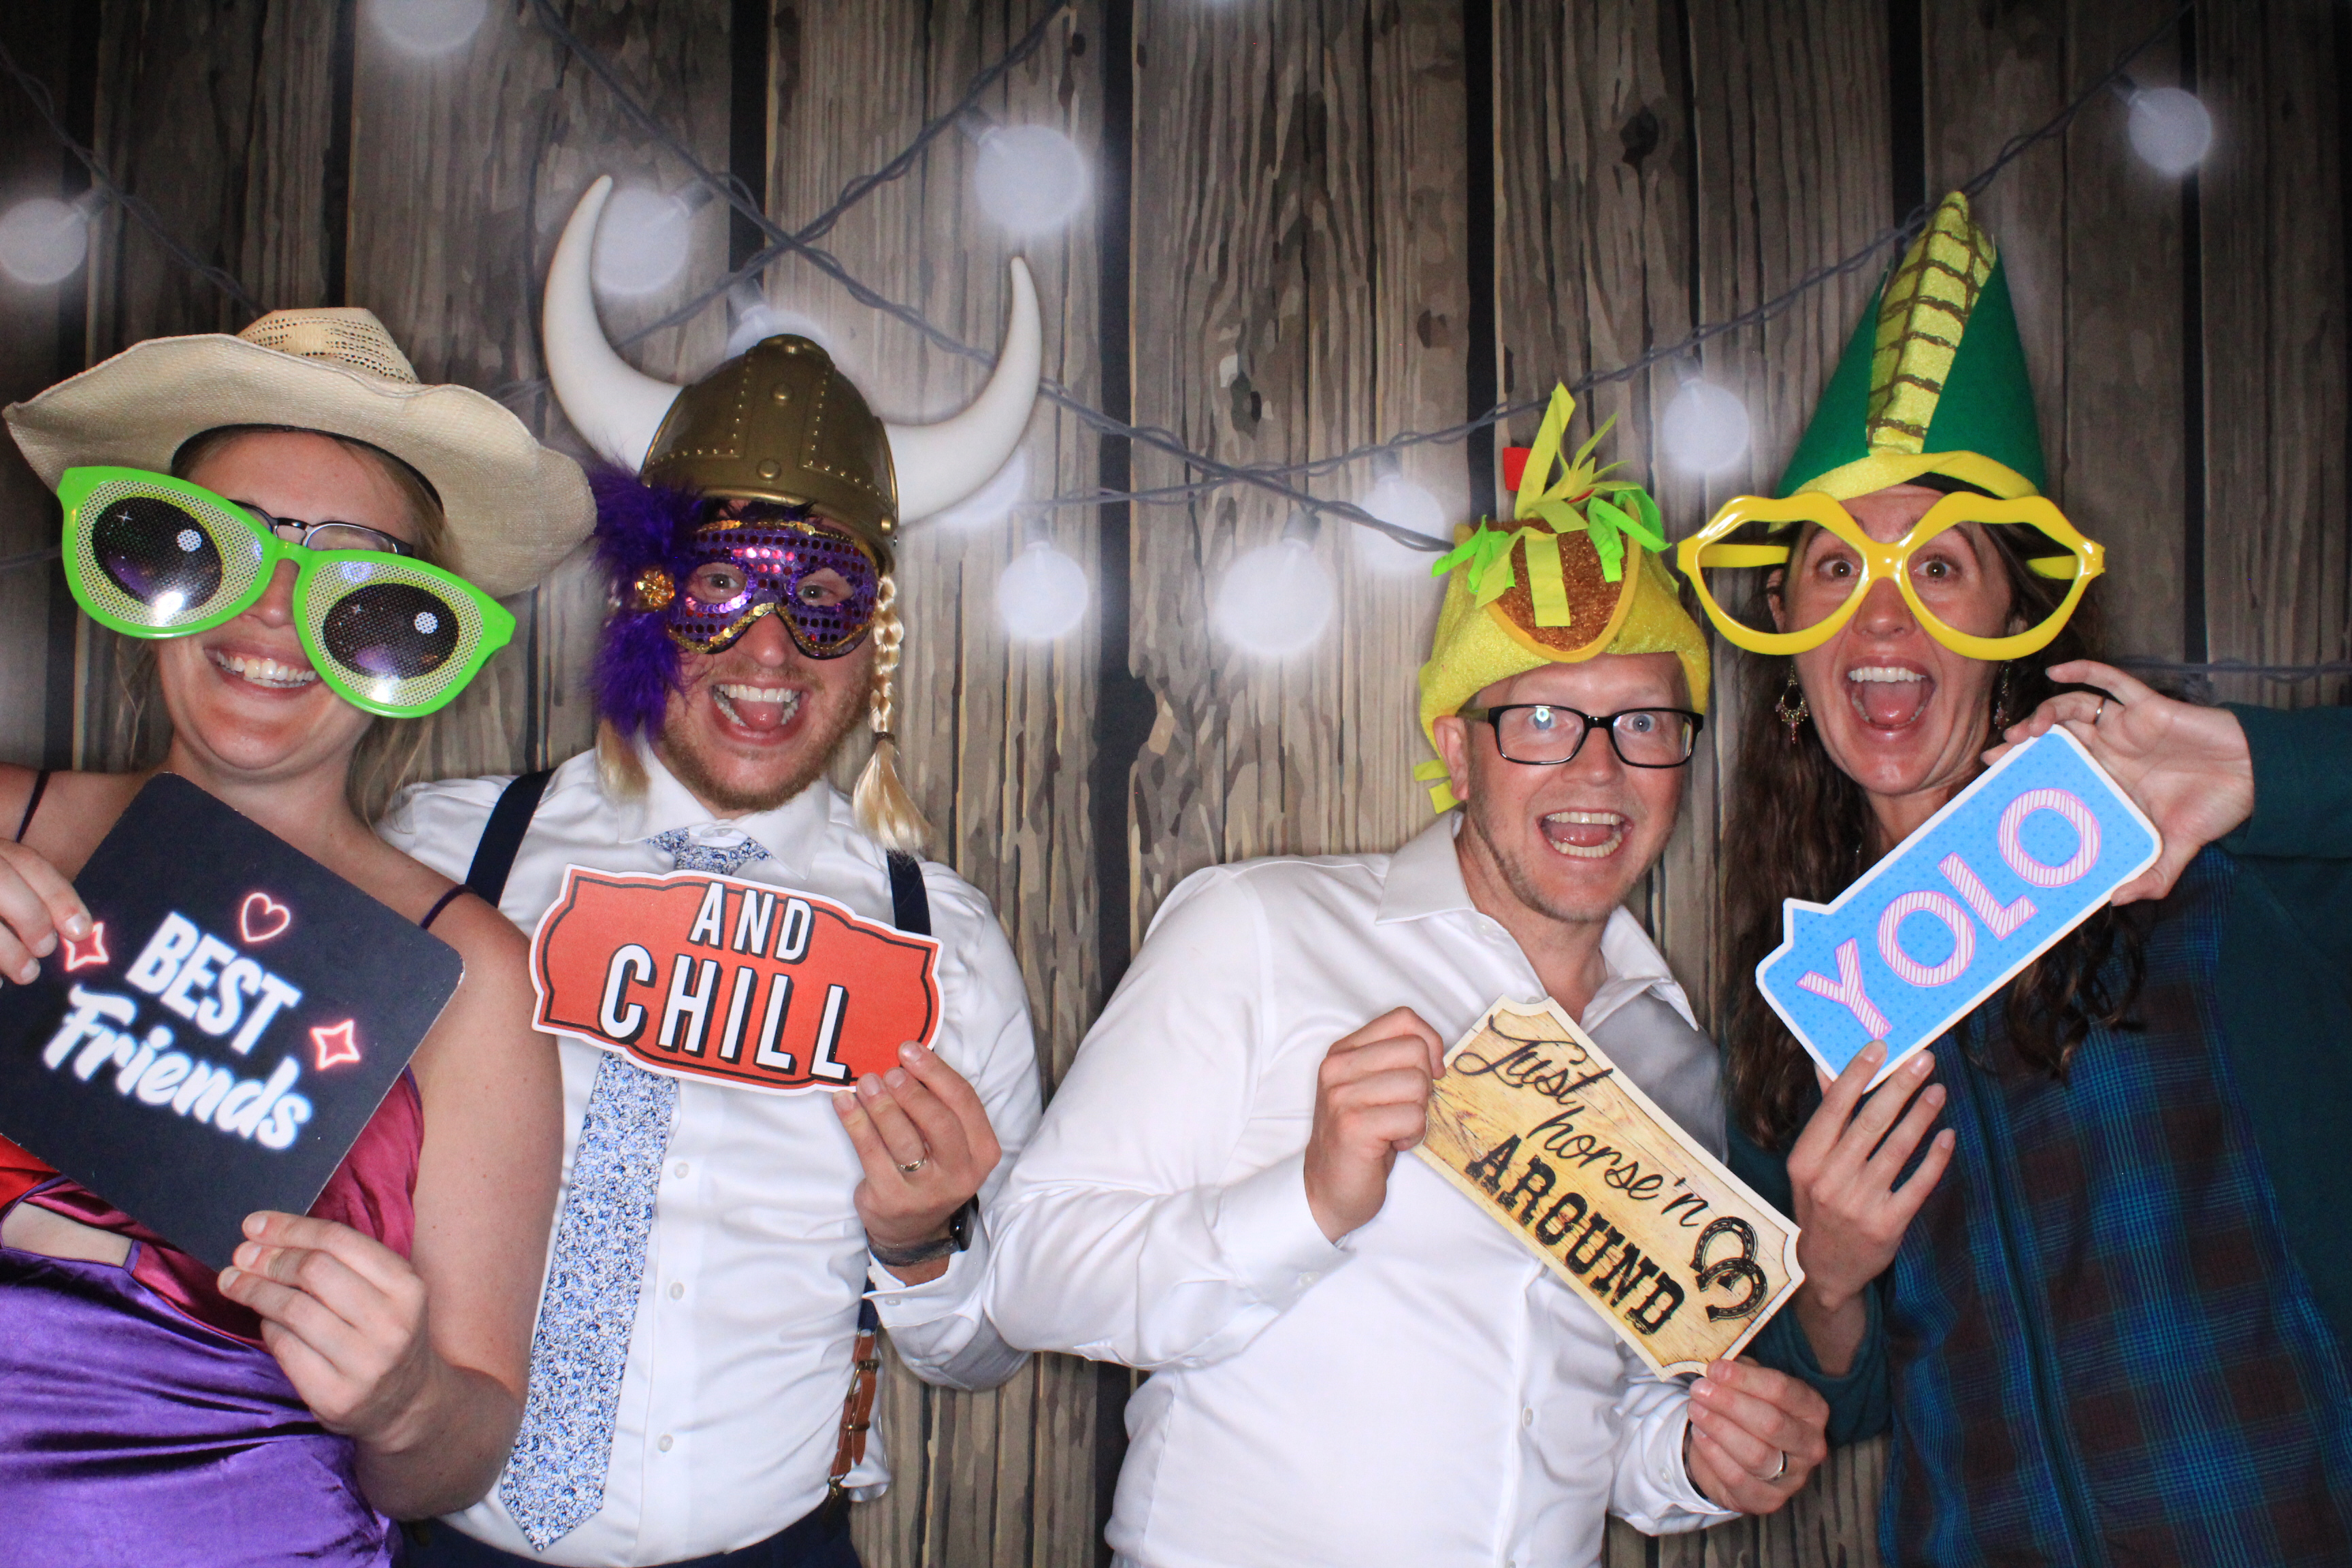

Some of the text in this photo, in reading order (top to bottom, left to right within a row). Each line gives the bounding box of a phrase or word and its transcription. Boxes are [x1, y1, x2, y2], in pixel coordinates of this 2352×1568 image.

[125, 911, 302, 1055] BEST
[689, 881, 814, 964] AND
[1795, 787, 2102, 1040] YOLO
[44, 985, 312, 1149] Friends
[599, 944, 851, 1085] CHILL
[1453, 1015, 1614, 1105] Just
[1465, 1134, 1685, 1335] AROUND
[1527, 1105, 1709, 1227] horse'n
